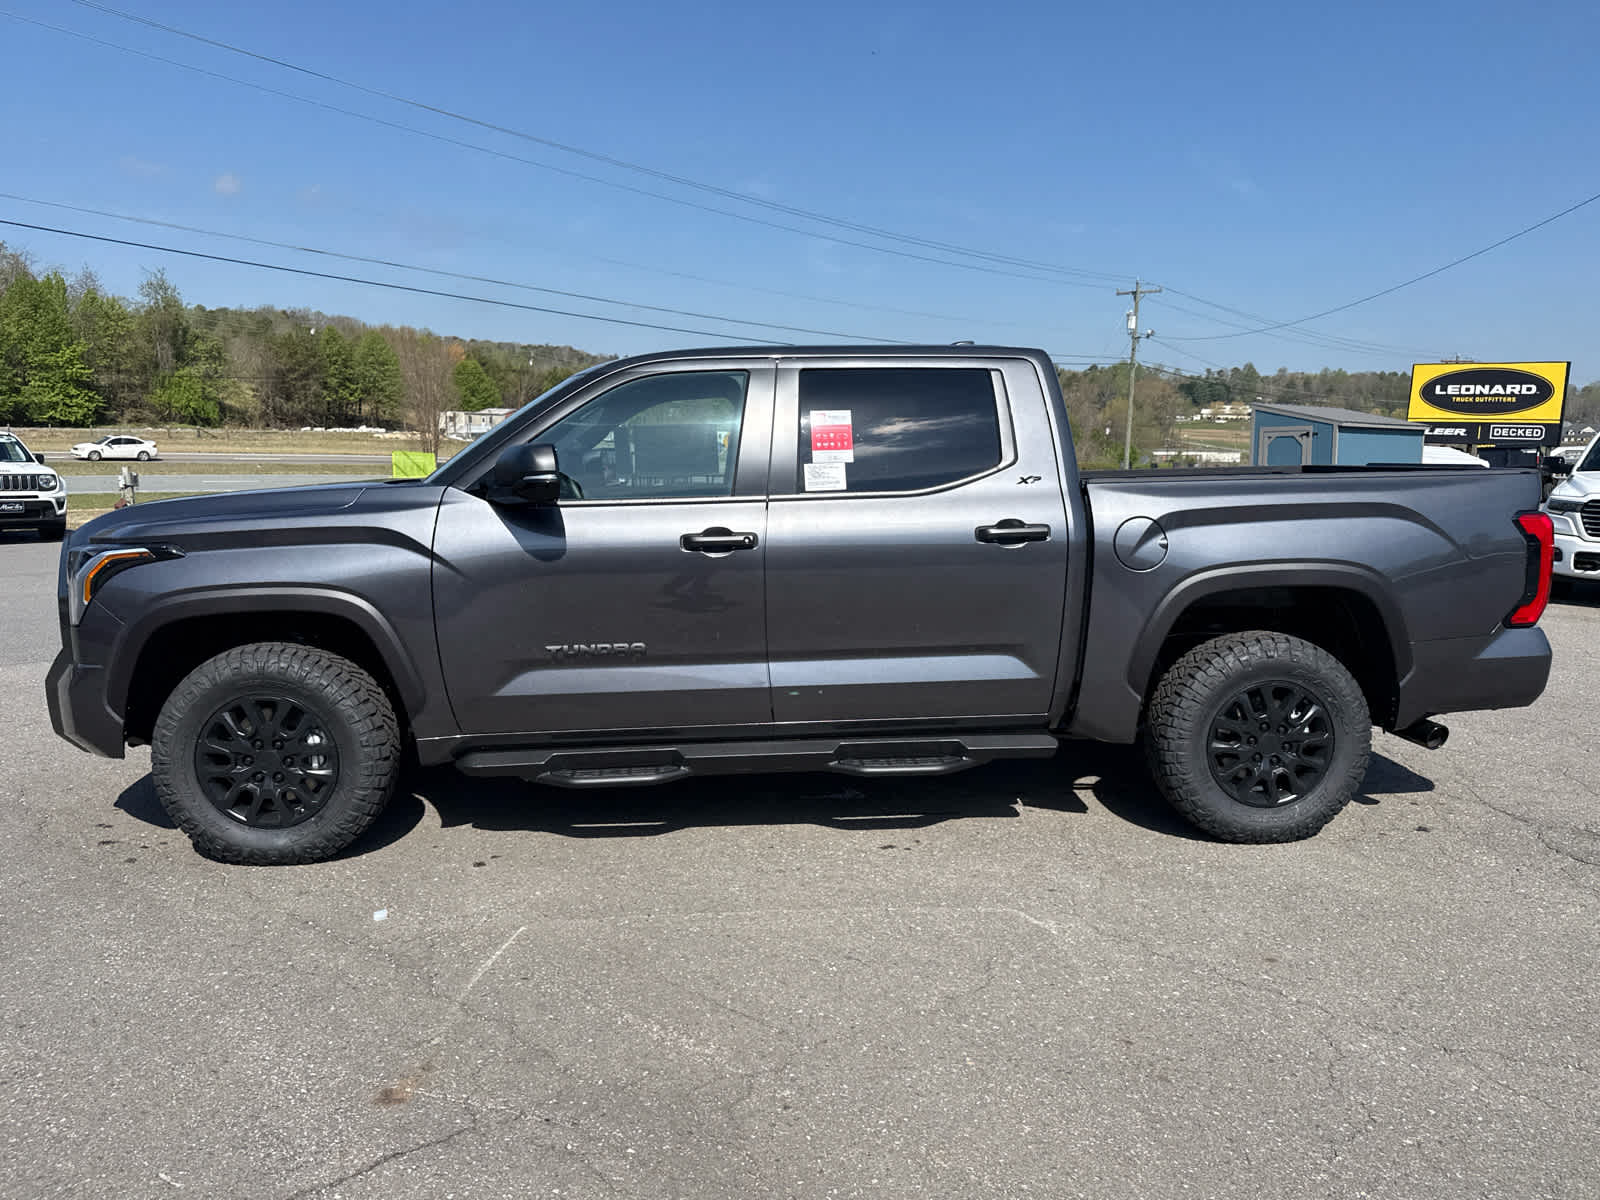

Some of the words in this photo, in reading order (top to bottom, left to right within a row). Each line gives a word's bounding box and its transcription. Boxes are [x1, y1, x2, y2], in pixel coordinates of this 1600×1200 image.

[1435, 384, 1537, 395] LEONARD
[1424, 427, 1466, 436] LEER
[1493, 428, 1541, 437] DECKED
[544, 642, 647, 655] TUNDRA
